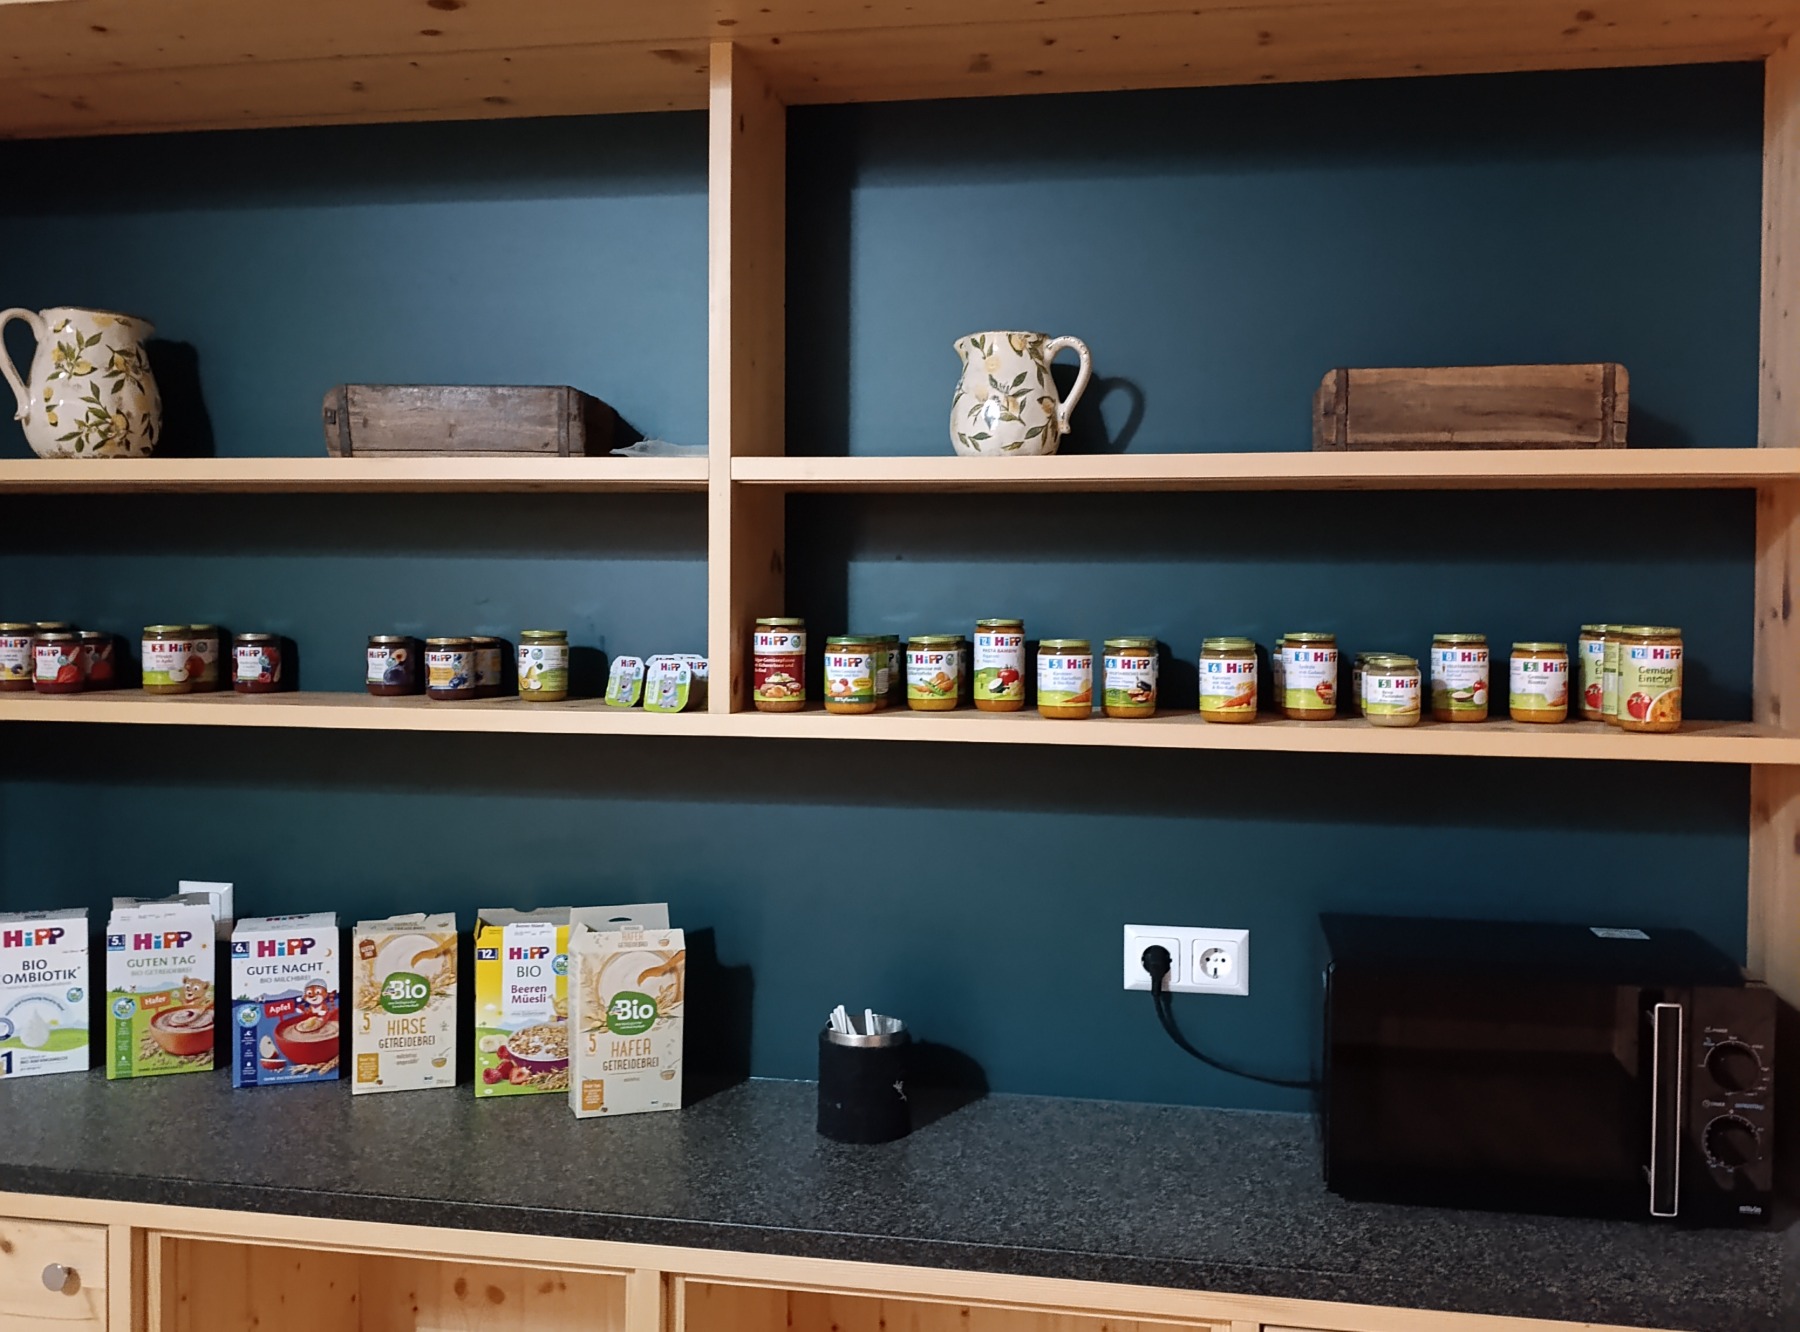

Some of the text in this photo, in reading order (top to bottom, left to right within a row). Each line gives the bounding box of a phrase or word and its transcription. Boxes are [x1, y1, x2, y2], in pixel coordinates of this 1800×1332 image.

[760, 636, 788, 645] HiPP
[995, 637, 1021, 646] HiPP
[915, 655, 943, 664] HiPP
[1462, 652, 1487, 661] HiPP
[1653, 649, 1681, 659] HiPP
[661, 663, 680, 671] HiPP
[834, 657, 862, 667] HiPP
[1067, 659, 1091, 669] HiPP
[1122, 659, 1149, 669] HiPP
[1227, 663, 1254, 673] HiPP
[3, 927, 65, 949] HiPP
[133, 931, 193, 951] HiPP
[258, 938, 316, 958] HiPP
[509, 946, 550, 960] HiPP
[22, 959, 48, 971] BIO
[127, 955, 197, 969] GUTEN TAG
[247, 962, 324, 976] GUTE NACHT
[516, 966, 541, 977] BIO
[0, 969, 79, 985] OMBIOTIK
[274, 975, 312, 983] MILCHBREI
[389, 979, 427, 1000] Bio
[511, 985, 547, 994] Beeren
[144, 996, 167, 1005] Hafer
[511, 993, 547, 1004] Müesli
[269, 1002, 292, 1014] Apfel
[615, 1000, 654, 1020] Bio
[362, 1013, 370, 1031] 5
[387, 1017, 427, 1036] HIRSE
[379, 1035, 436, 1049] GETREIDEBREI
[588, 1034, 597, 1053] 5
[611, 1038, 651, 1057] HAFER
[1, 1051, 13, 1074] 1
[602, 1056, 660, 1071] GETREIDEBREI
